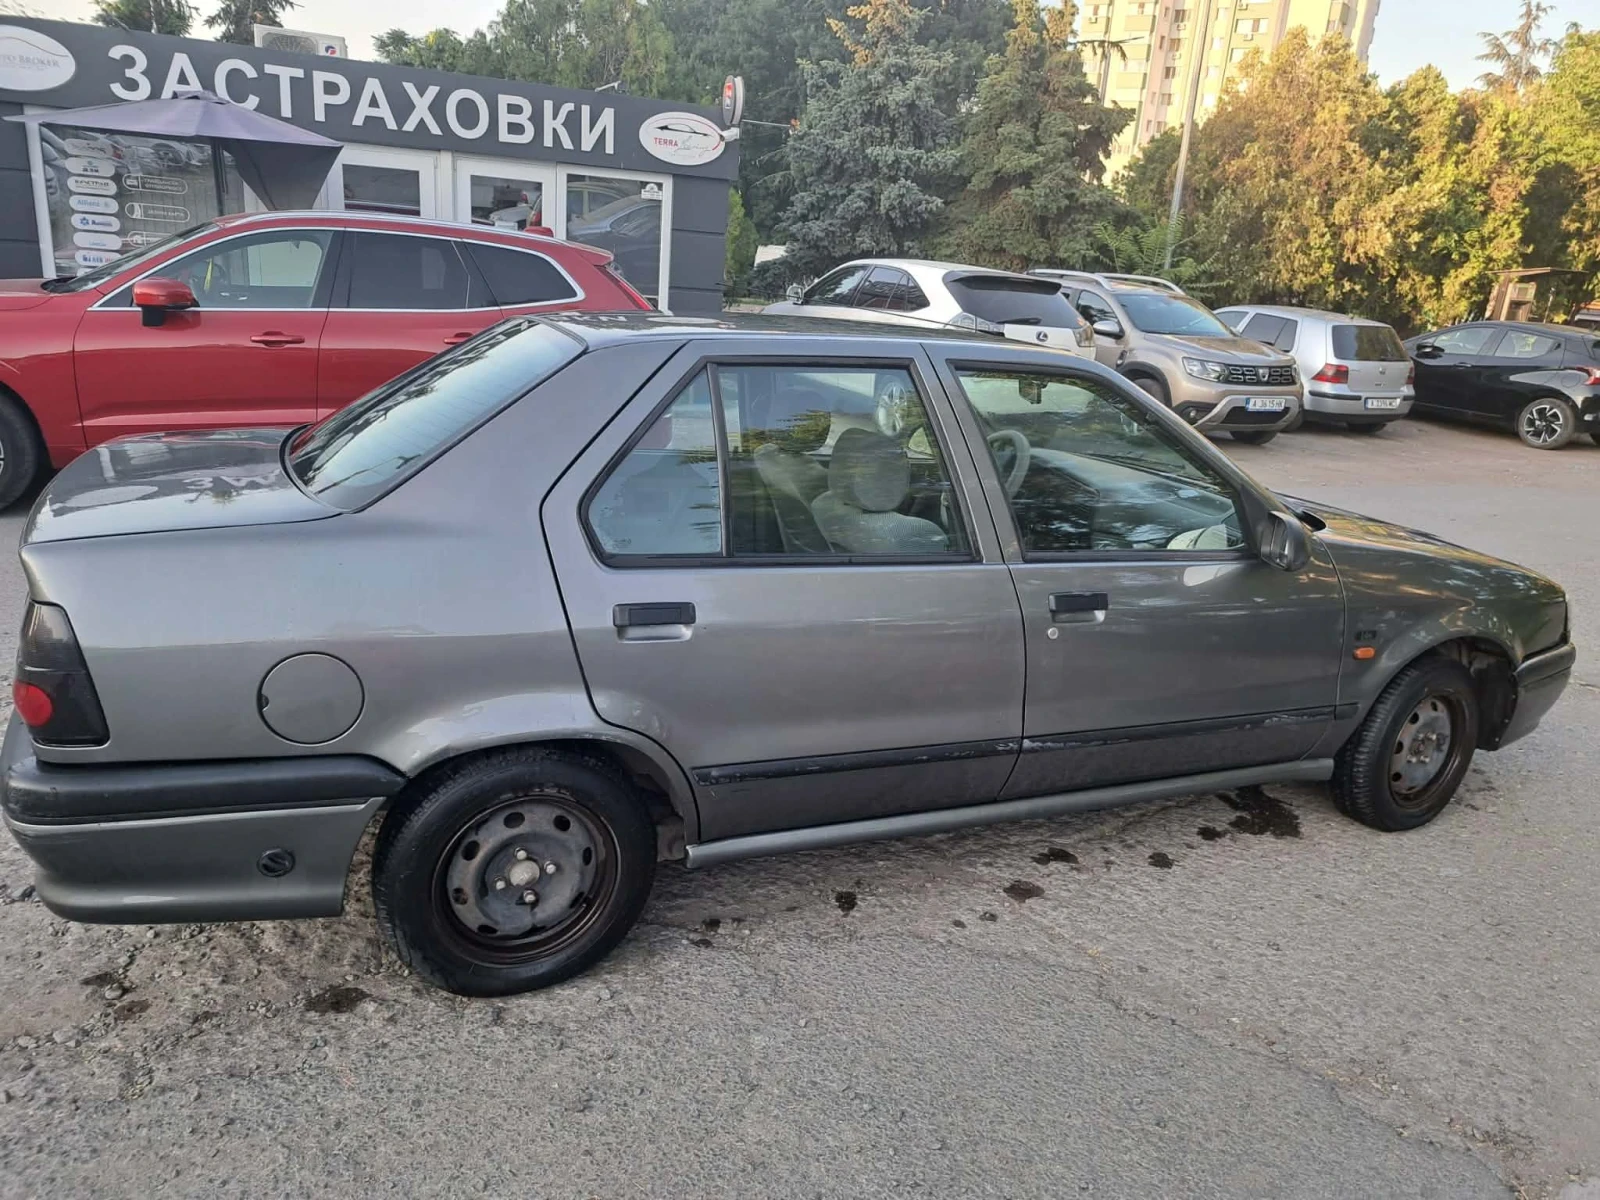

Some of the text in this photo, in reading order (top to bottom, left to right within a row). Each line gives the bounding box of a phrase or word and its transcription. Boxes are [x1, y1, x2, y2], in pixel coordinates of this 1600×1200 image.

[18, 55, 61, 69] BROKER
[107, 44, 615, 156] ЗАСТРАХОВКИ
[653, 137, 679, 148] TERRA
